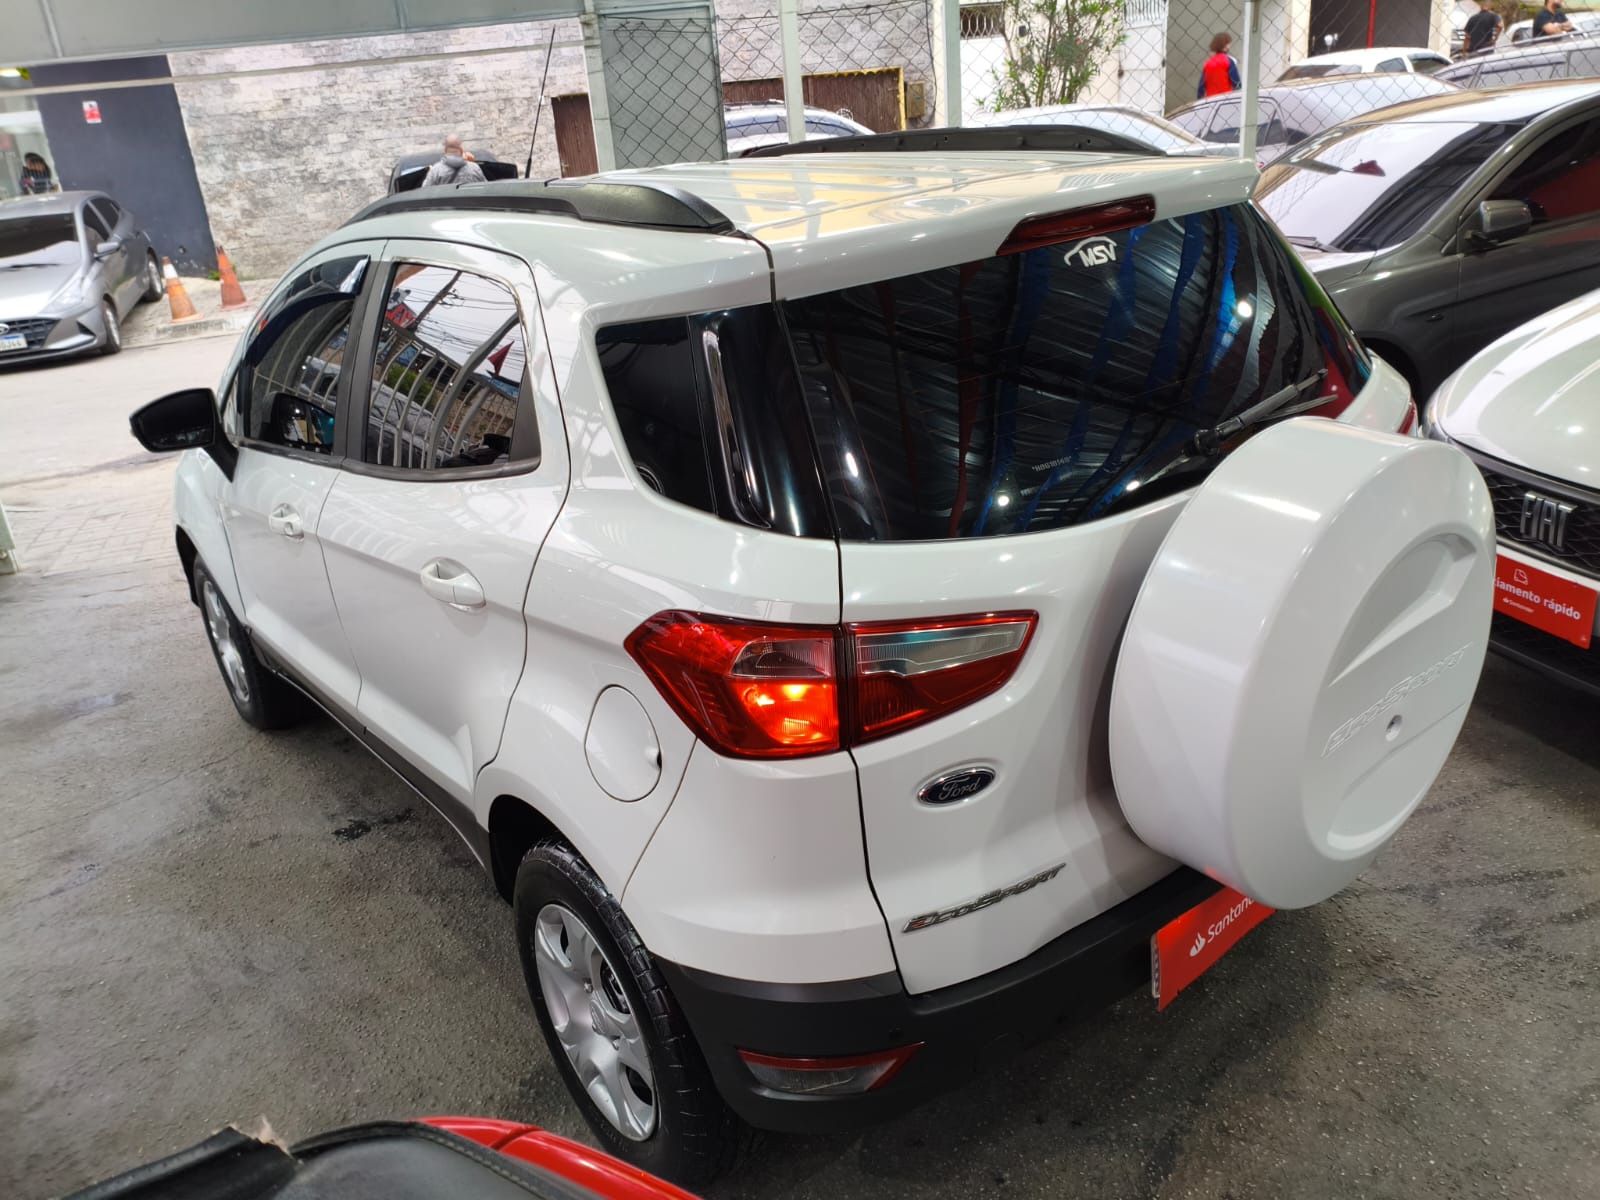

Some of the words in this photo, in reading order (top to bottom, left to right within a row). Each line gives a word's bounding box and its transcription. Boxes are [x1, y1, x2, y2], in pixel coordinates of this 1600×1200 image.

[1079, 244, 1117, 267] MSV
[1520, 491, 1578, 548] FIAT
[1543, 598, 1581, 620] rápido
[938, 776, 982, 800] Ford
